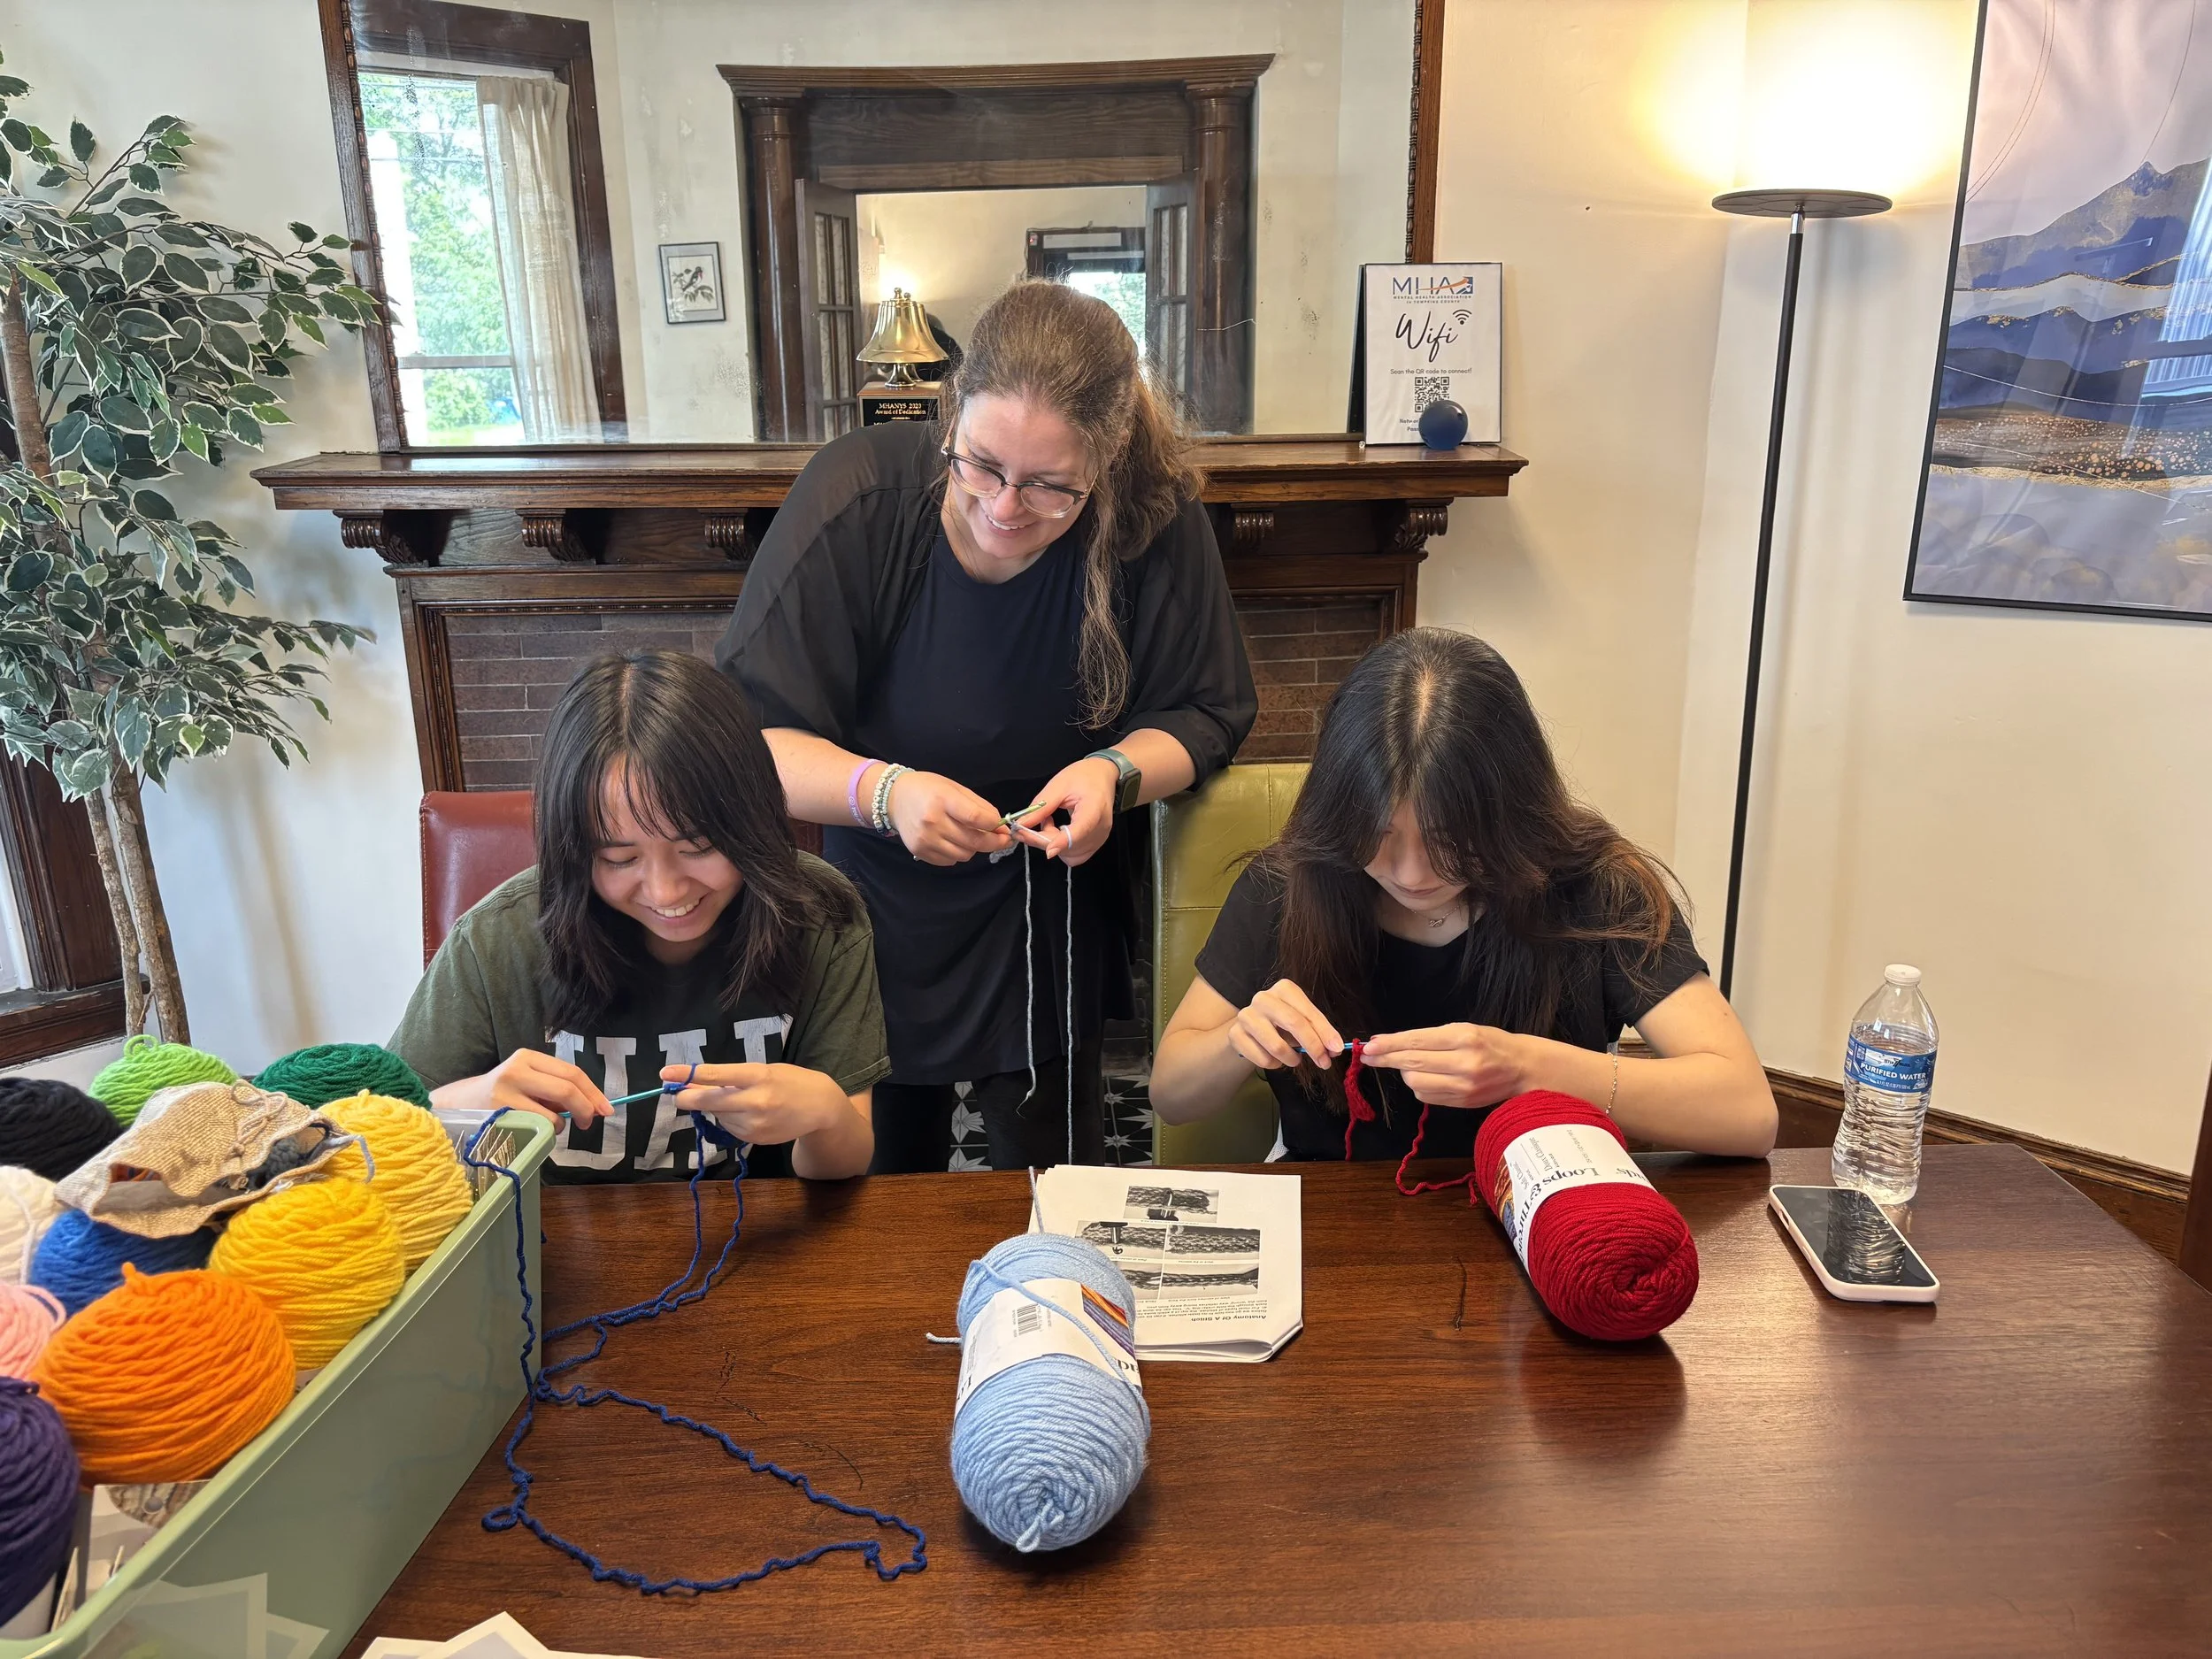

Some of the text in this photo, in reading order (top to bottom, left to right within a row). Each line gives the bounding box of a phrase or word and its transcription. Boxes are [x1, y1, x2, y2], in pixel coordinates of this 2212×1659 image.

[1394, 311, 1459, 363] Wifi
[1860, 1063, 1898, 1079] PURIFIED
[1542, 1167, 1601, 1186] Loops
